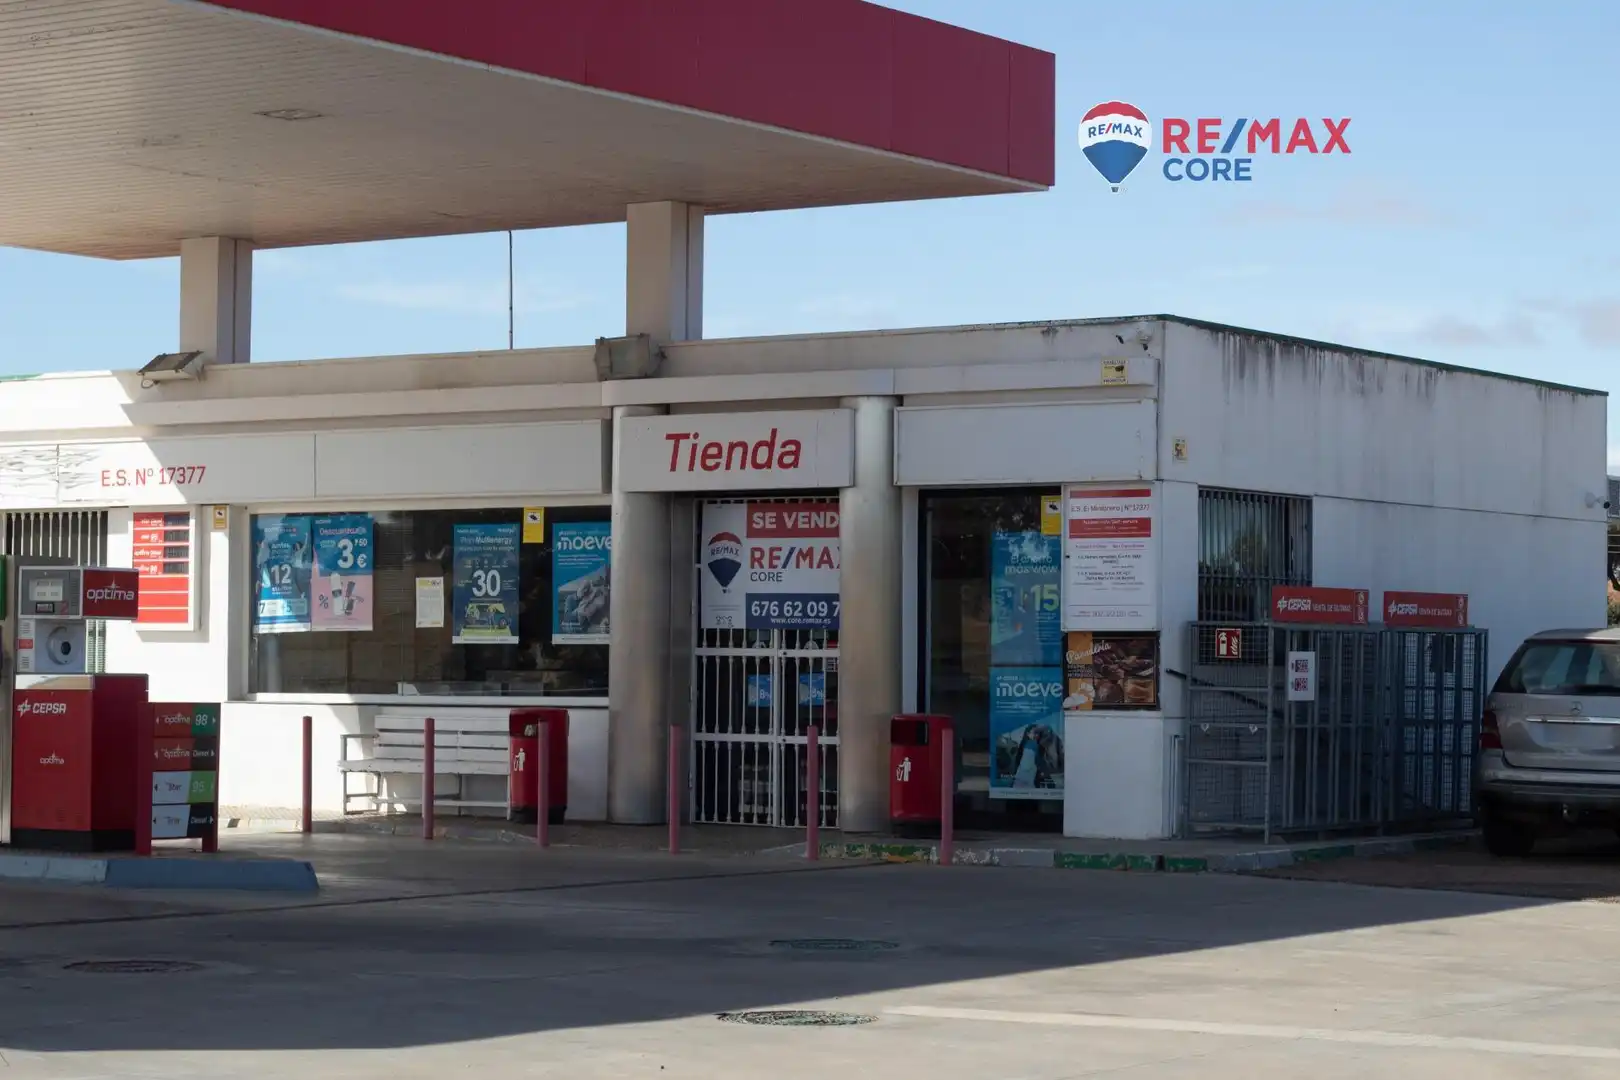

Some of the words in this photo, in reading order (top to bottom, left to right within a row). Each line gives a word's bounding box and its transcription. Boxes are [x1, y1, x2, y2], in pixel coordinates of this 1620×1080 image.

[665, 428, 801, 472] Tienda
[101, 469, 131, 487] E.S.
[159, 464, 206, 485] 17377
[752, 511, 777, 529] SE
[557, 536, 613, 551] moeve
[710, 544, 740, 557] RE/MAX
[271, 564, 292, 585] 12
[750, 571, 783, 582] CORE
[472, 569, 501, 598] 30
[86, 583, 135, 603] optima
[1031, 584, 1060, 612] 15
[751, 601, 779, 617] 676
[784, 601, 803, 617] 62
[807, 601, 828, 617] 09
[1288, 598, 1312, 611] CEPSA
[996, 682, 1064, 698] moeve
[32, 702, 67, 714] CEPSA
[39, 755, 65, 768] optima
